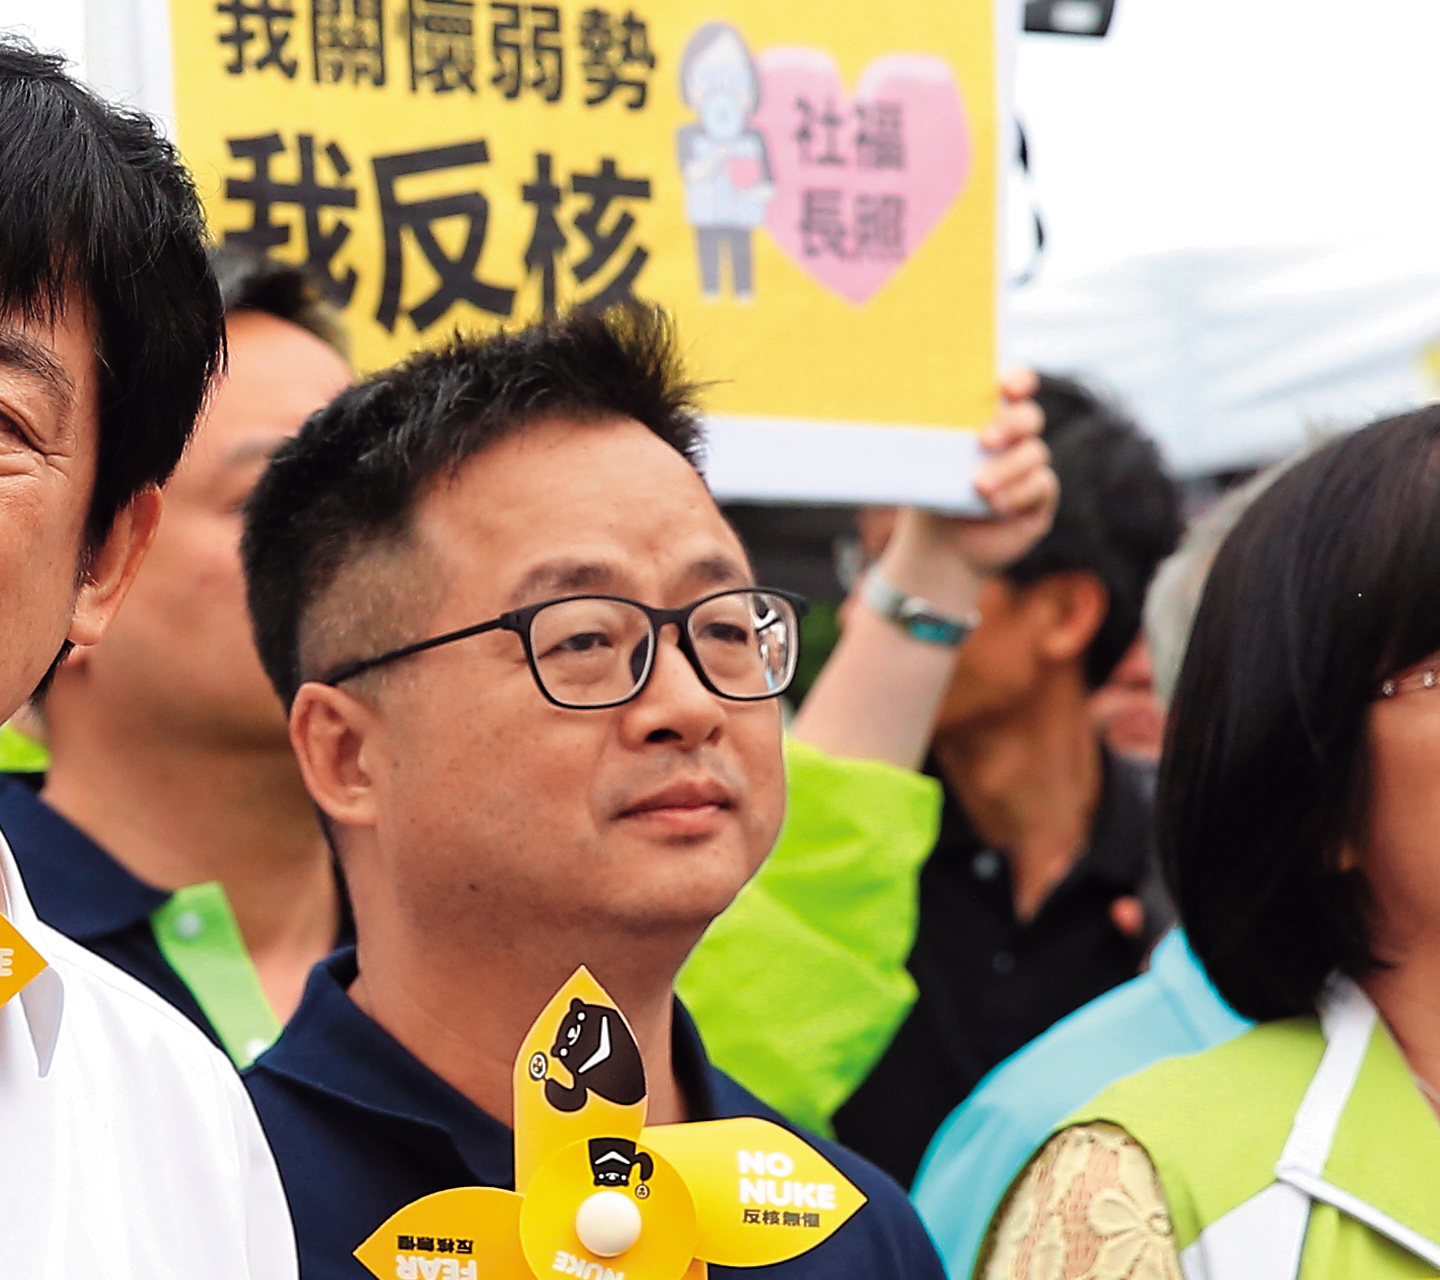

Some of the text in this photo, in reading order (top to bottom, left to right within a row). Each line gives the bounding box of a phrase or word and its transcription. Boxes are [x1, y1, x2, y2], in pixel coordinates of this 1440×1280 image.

[794, 96, 907, 170] 社福
[222, 131, 656, 334] 我反核
[736, 1149, 793, 1178] NO
[737, 1177, 837, 1210] NUKE
